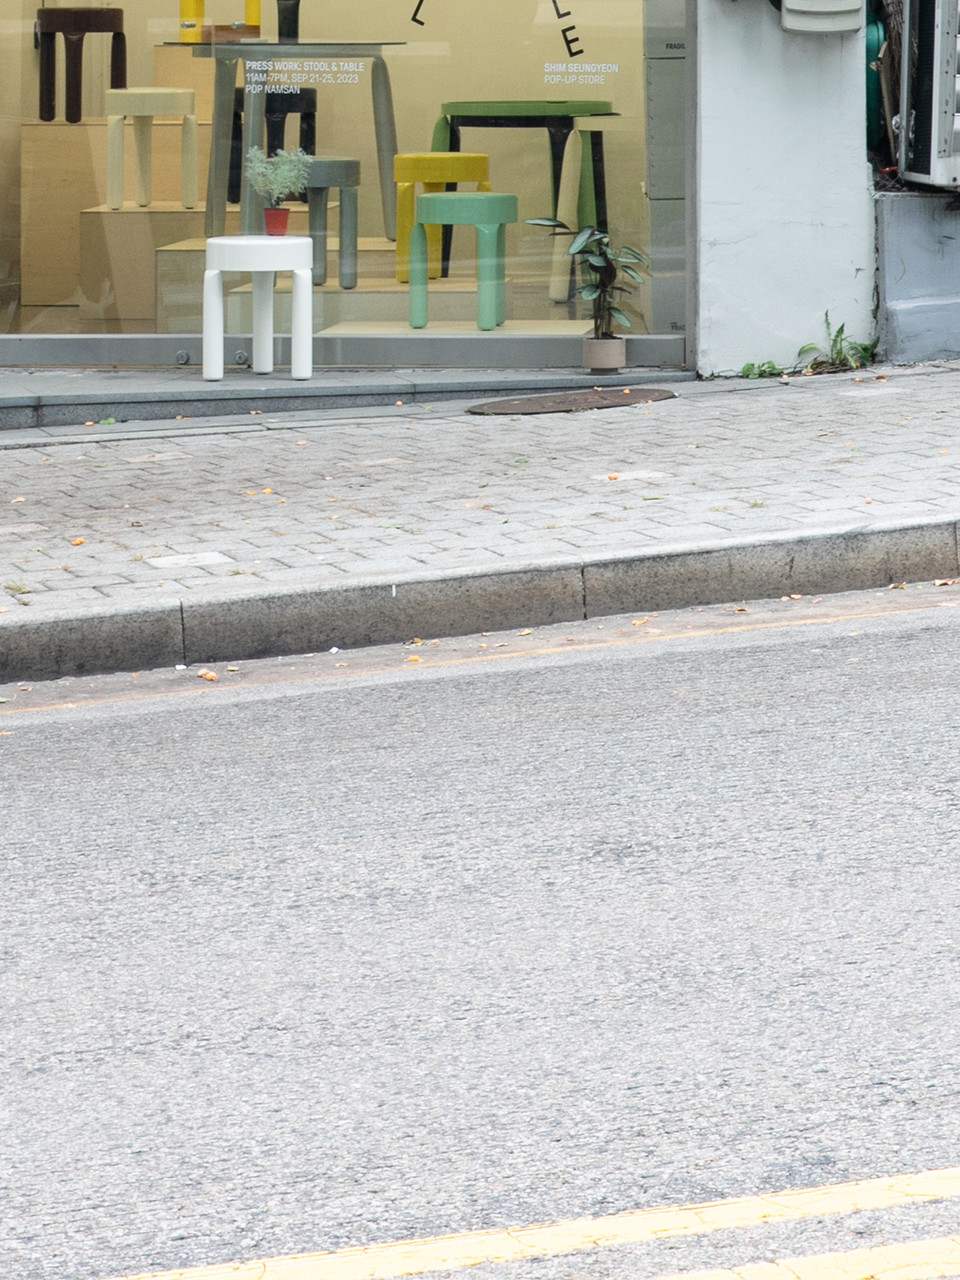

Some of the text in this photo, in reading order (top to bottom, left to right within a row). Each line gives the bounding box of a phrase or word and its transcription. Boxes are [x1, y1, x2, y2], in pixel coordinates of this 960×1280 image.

[245, 61, 364, 72] PRESS WORK: STOOL & TABLE
[544, 63, 619, 73] SHIM SEUNGYEON
[246, 73, 359, 83] 11AM-7PM, SEP 21-25, 2023
[544, 74, 606, 84] POP-UP STORE
[245, 84, 301, 94] POP NAMSAN
